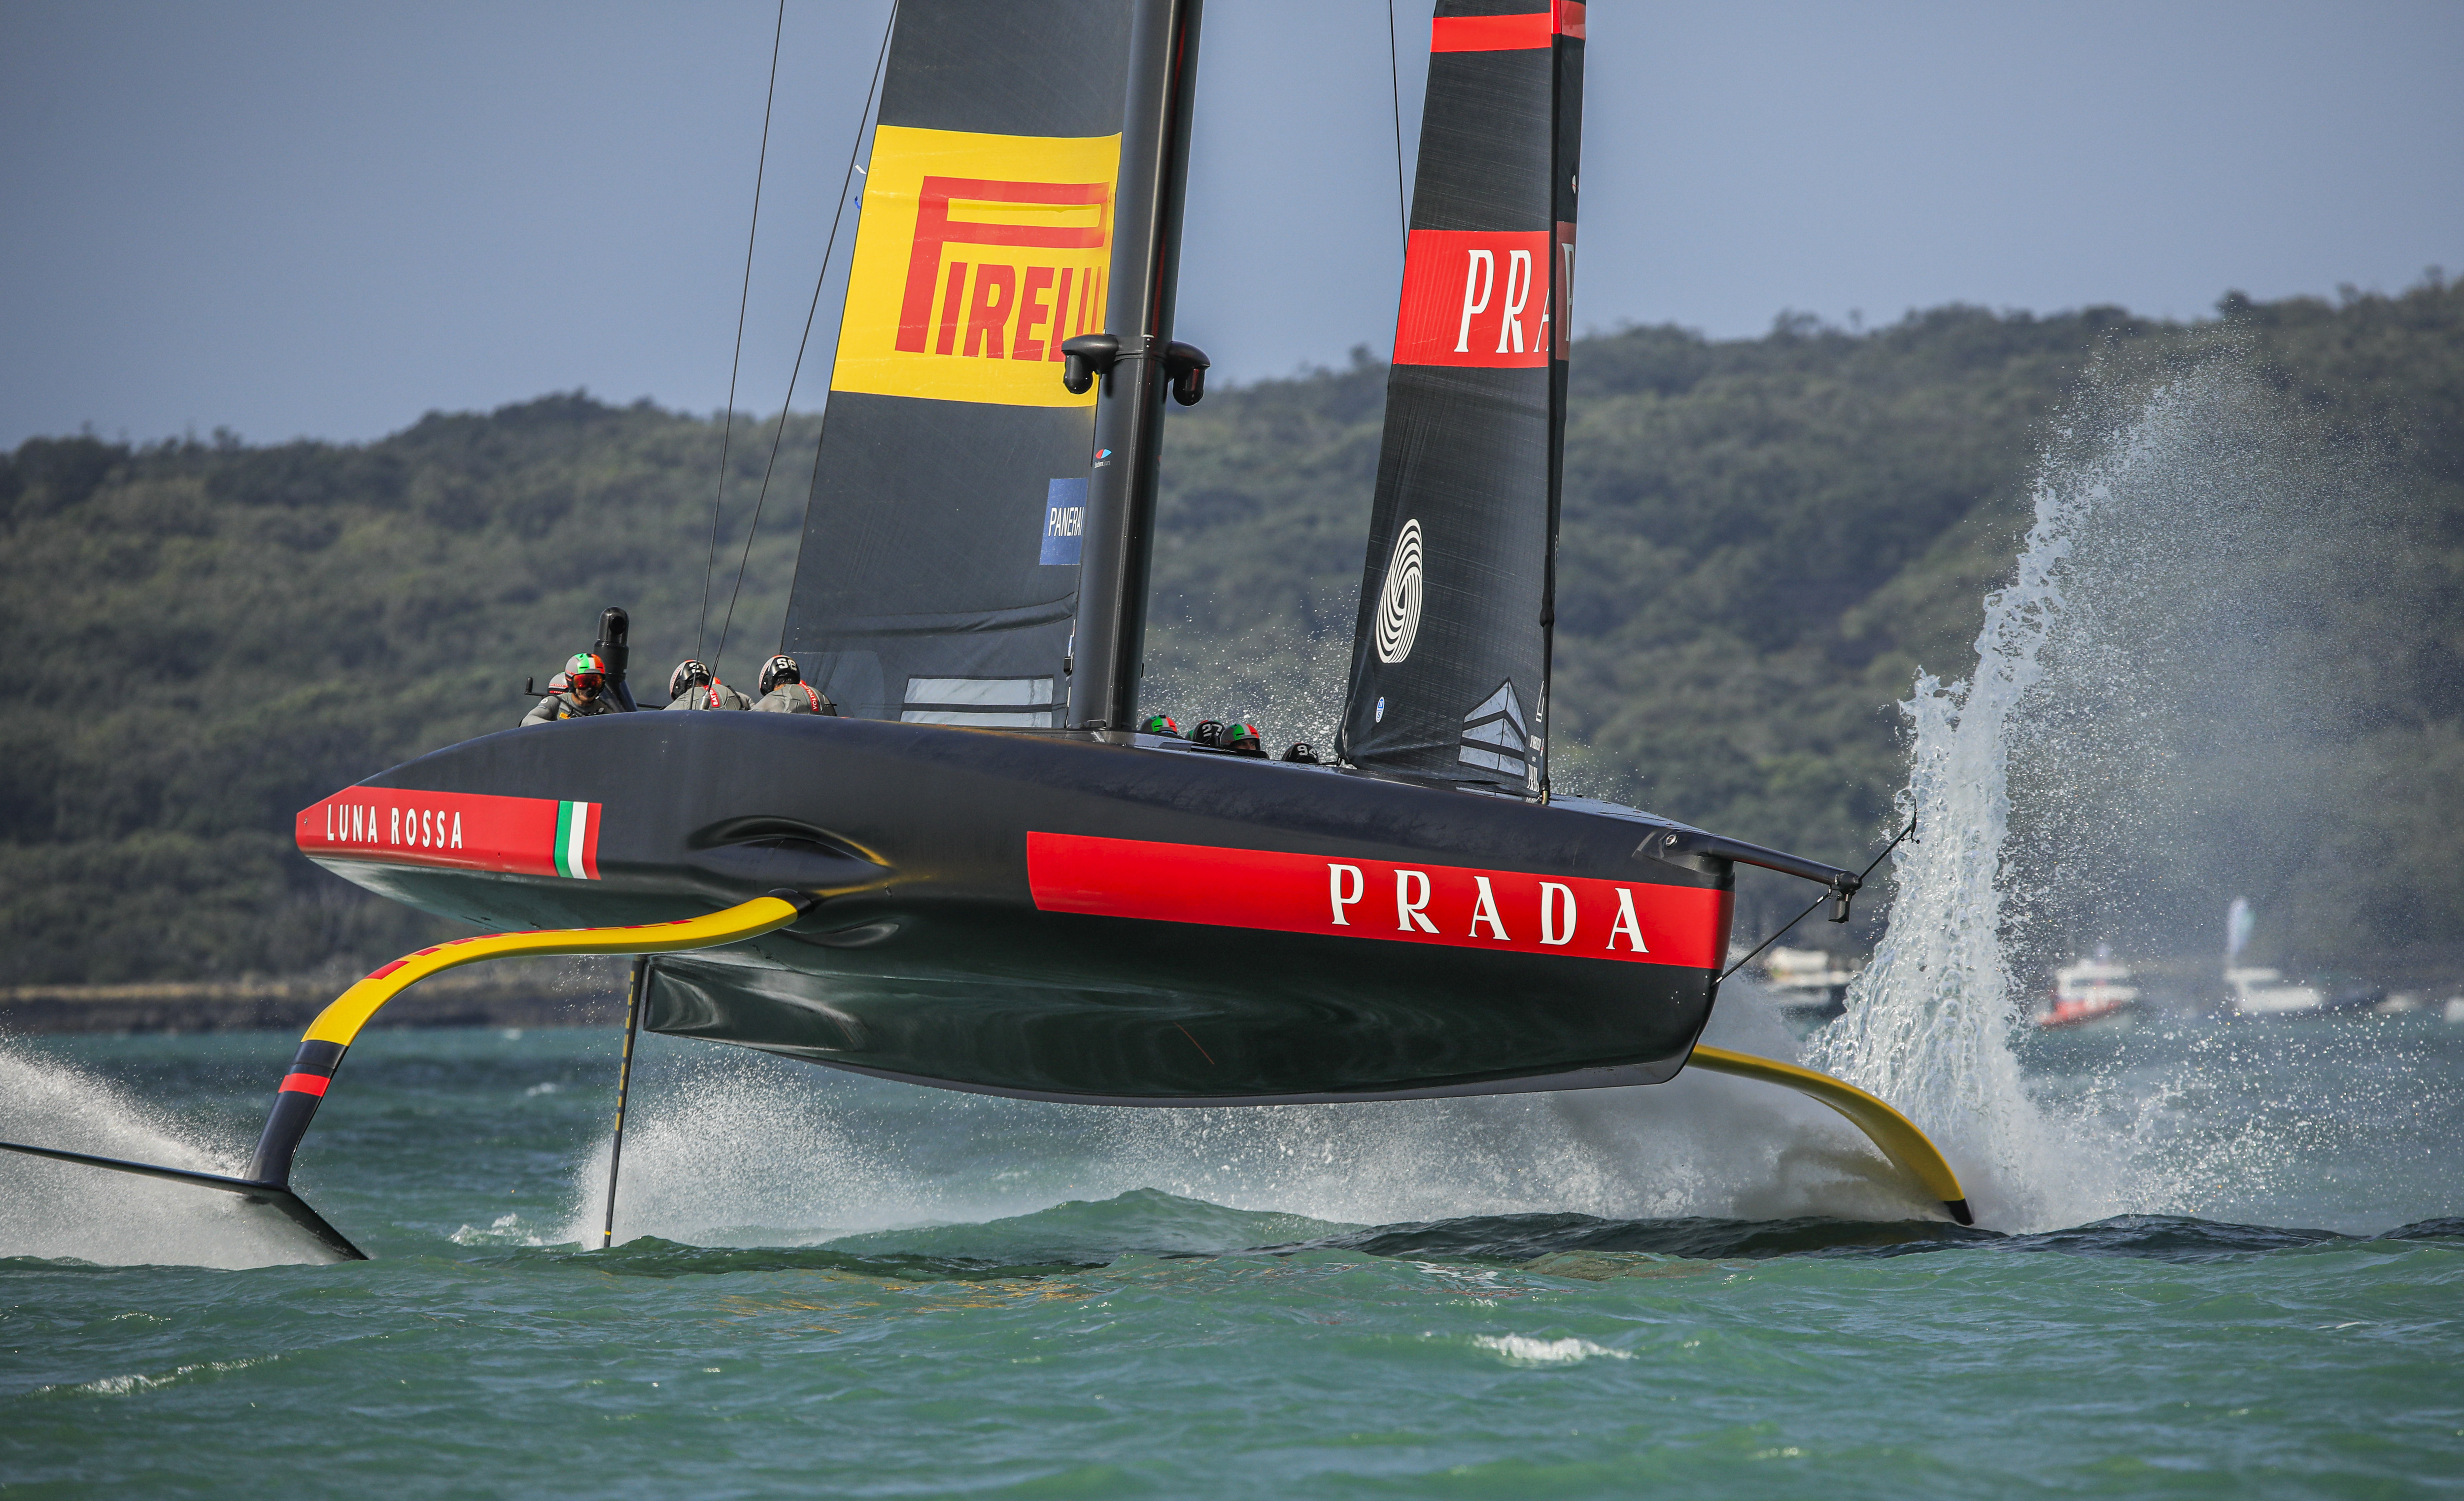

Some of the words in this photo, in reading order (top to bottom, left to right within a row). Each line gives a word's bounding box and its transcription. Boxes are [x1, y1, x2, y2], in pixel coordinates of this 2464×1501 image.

[1048, 507, 1084, 537] PANERAI
[1202, 724, 1223, 737] 27
[327, 803, 378, 843] LUNA
[390, 806, 463, 849] ROSSA
[1327, 863, 1649, 953] PRADA
